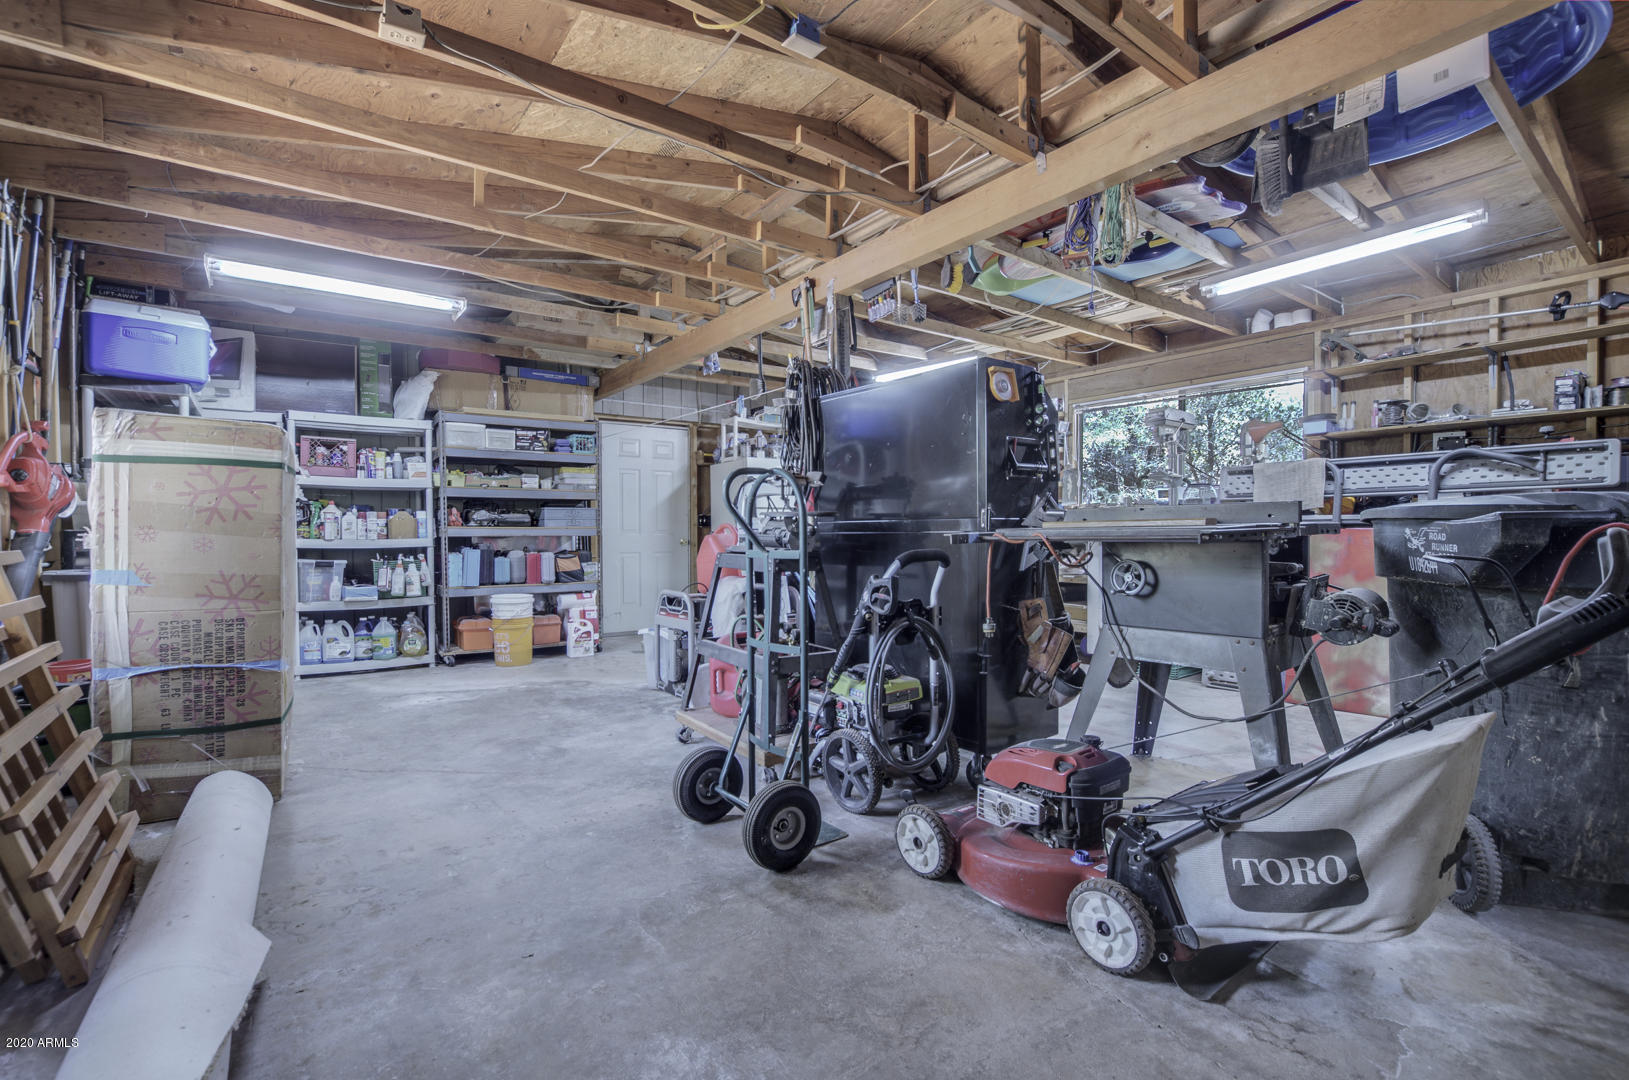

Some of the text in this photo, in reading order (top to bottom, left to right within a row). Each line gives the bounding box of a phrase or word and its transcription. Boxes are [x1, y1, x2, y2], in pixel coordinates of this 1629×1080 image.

[98, 290, 140, 300] LIFT-AWAY
[1429, 532, 1446, 541] ROAD
[1431, 542, 1458, 552] RUNNER
[158, 621, 169, 640] CASE
[170, 620, 180, 639] CASE
[225, 618, 234, 632] SKU
[181, 620, 191, 653] COUNTRY
[192, 619, 202, 655] PURCHASE
[204, 632, 214, 662] MIRACLE
[236, 618, 246, 660] DEPARTMENT
[171, 688, 181, 698] PC
[236, 670, 246, 696] UMBER:
[183, 699, 192, 722] CHINA
[1232, 855, 1348, 886] TORO
